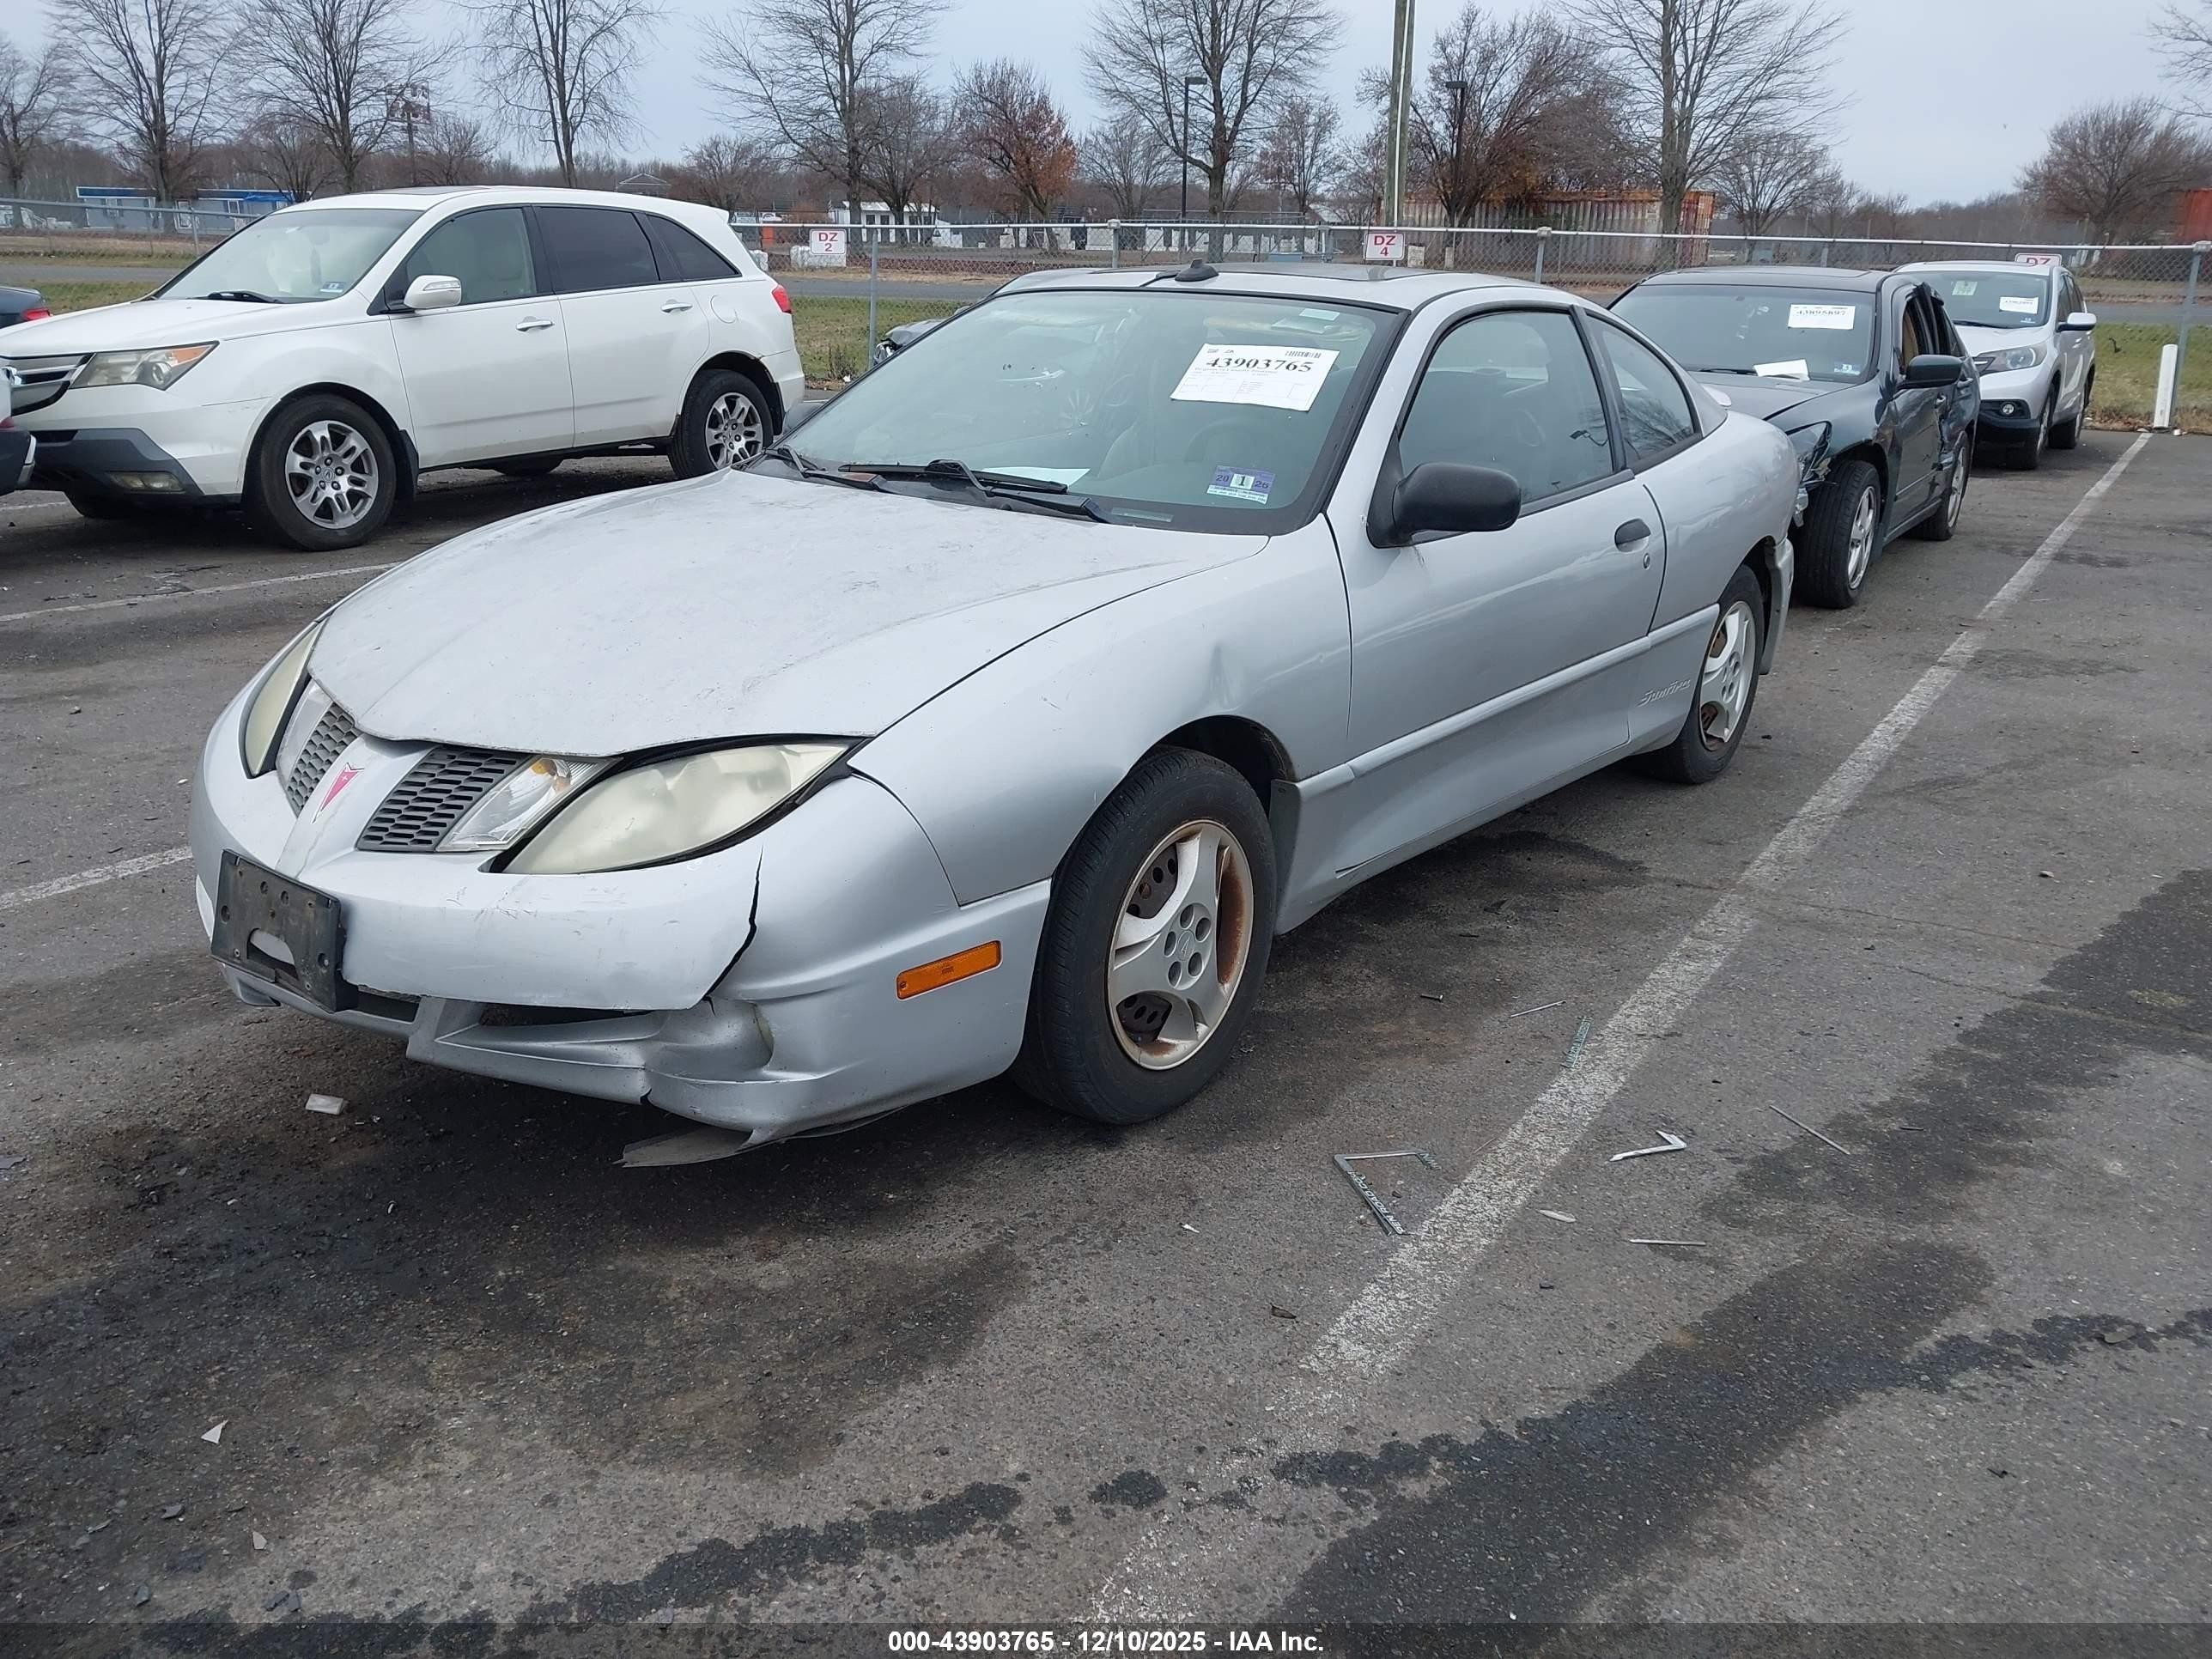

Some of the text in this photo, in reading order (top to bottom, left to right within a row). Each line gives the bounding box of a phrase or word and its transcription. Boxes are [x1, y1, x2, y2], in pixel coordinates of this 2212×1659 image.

[818, 232, 839, 242] DZ
[1374, 234, 1396, 246] DZ
[824, 242, 833, 252] 2
[1380, 246, 1389, 257] 4
[1206, 357, 1315, 372] 43903765
[1215, 474, 1269, 489] 20 1 26
